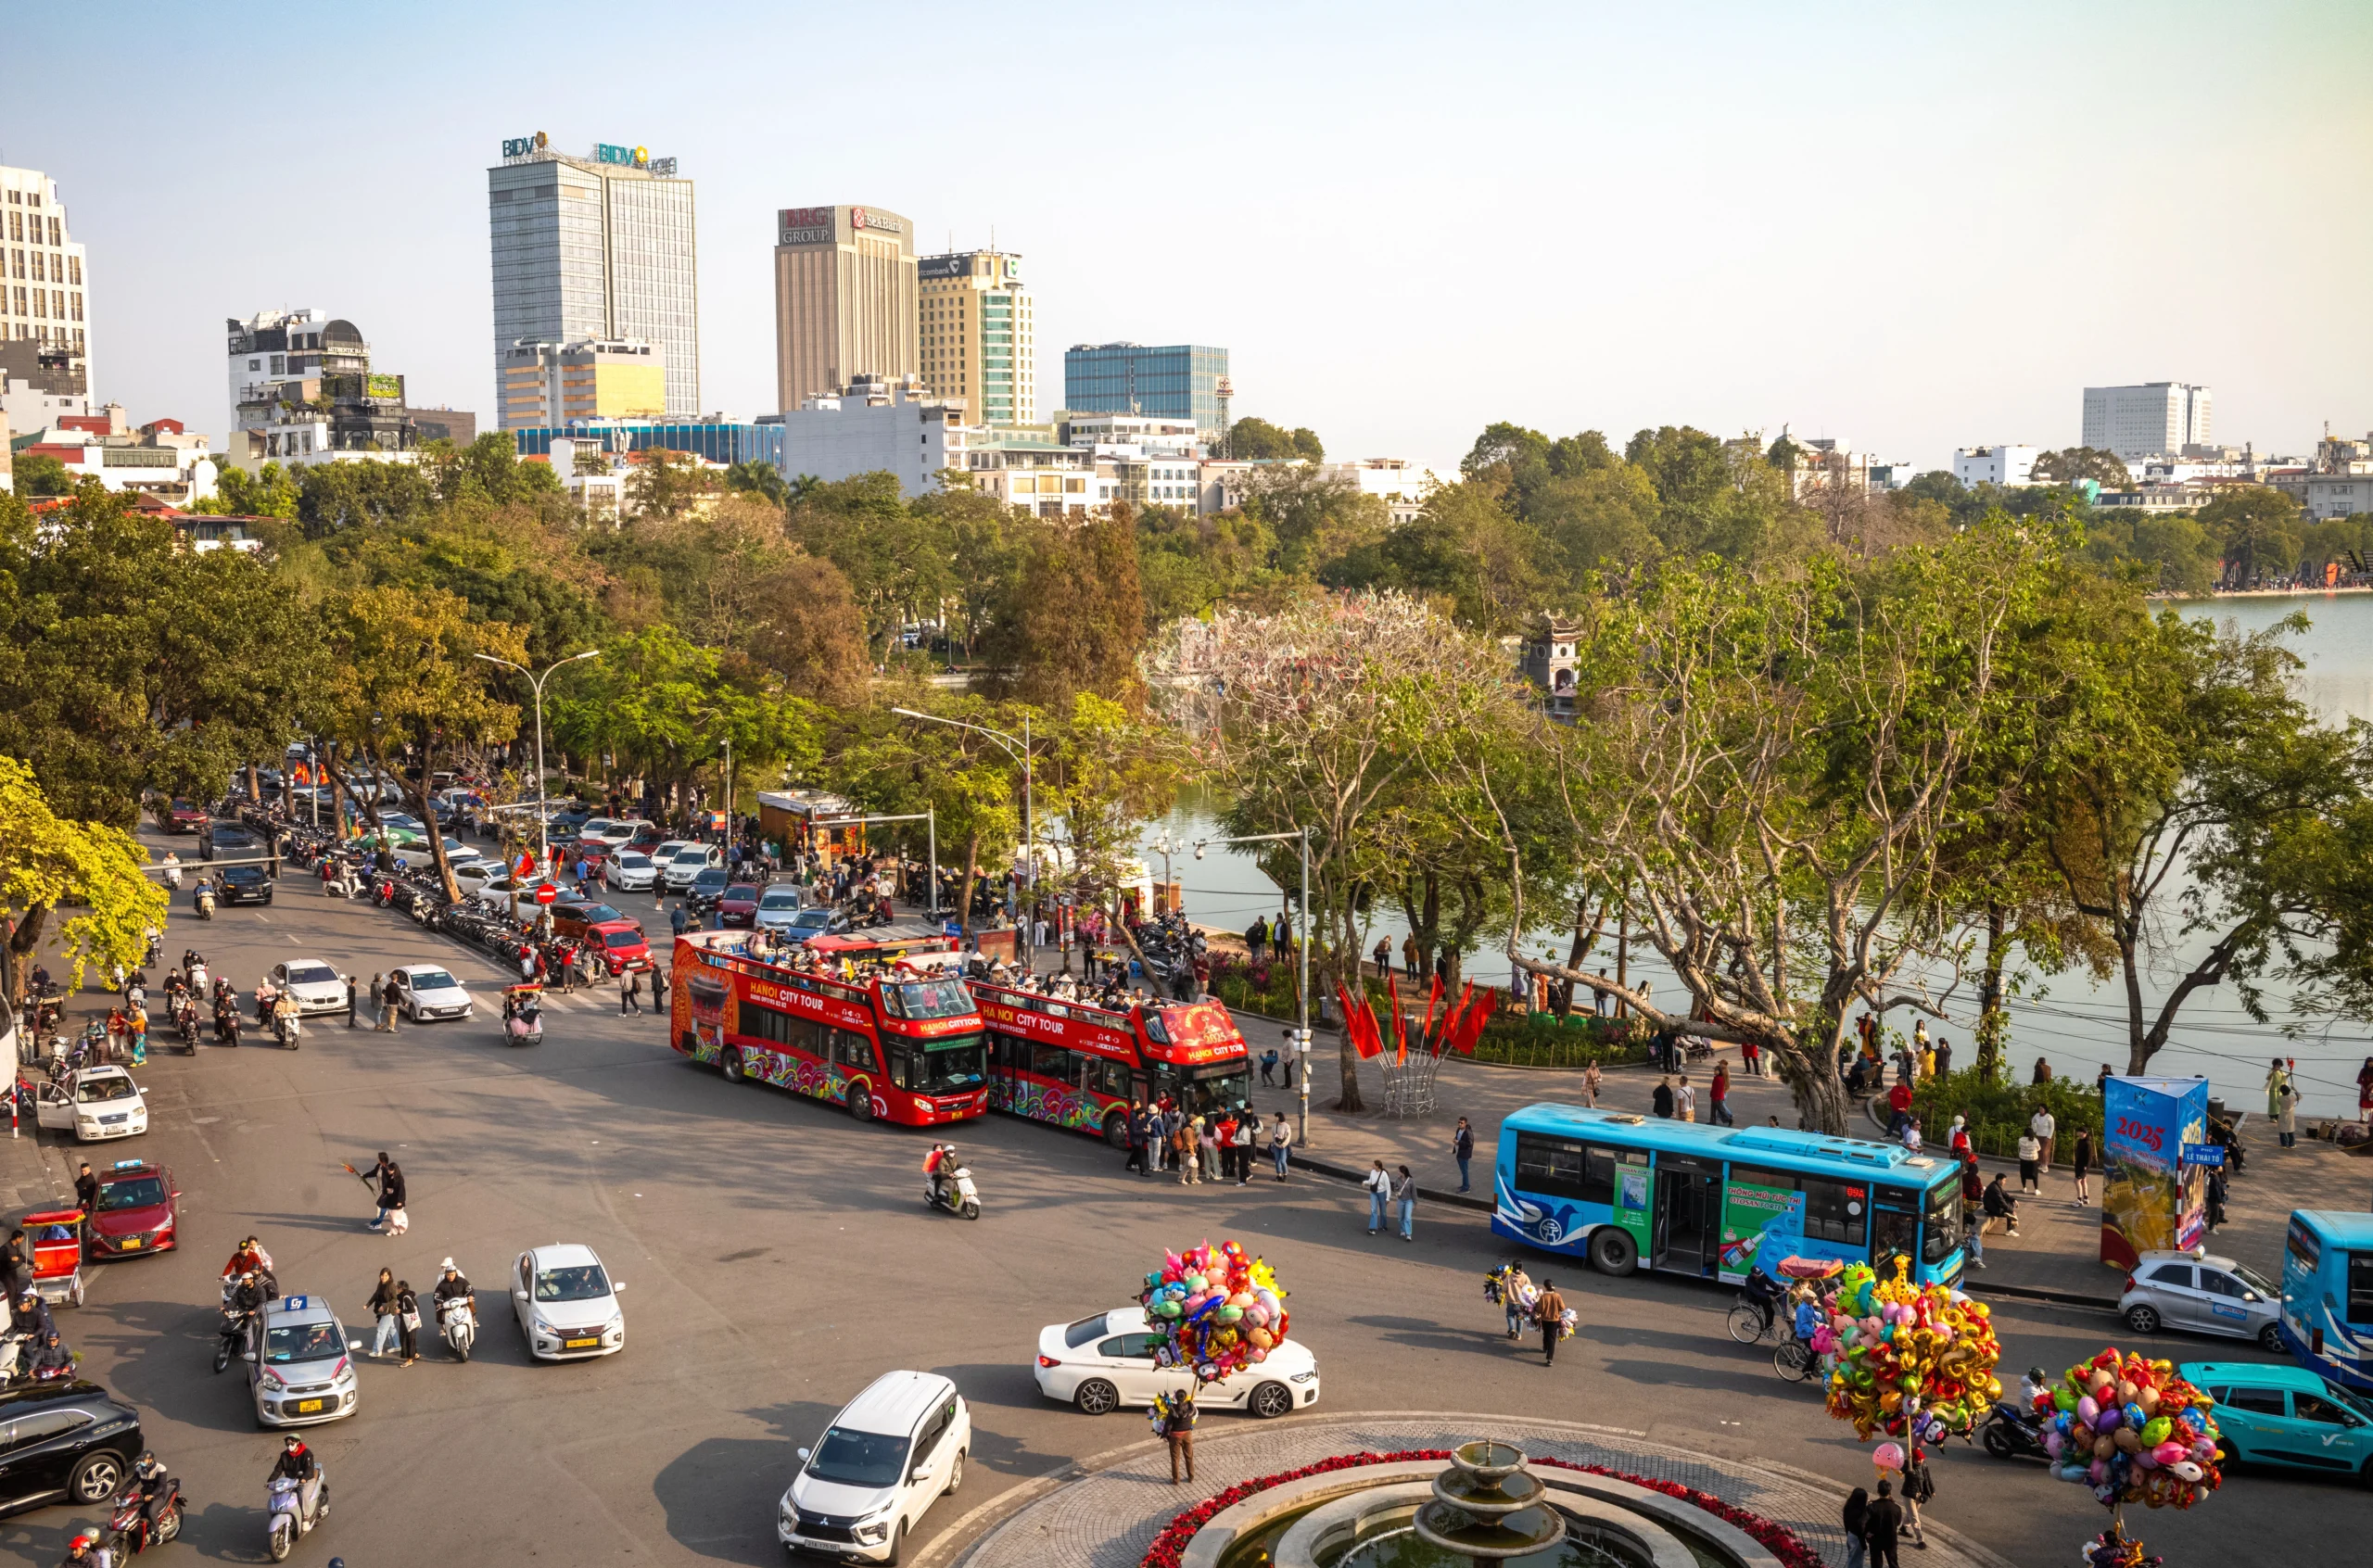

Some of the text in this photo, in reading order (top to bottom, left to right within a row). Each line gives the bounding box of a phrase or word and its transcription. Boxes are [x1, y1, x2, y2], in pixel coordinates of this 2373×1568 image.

[502, 136, 535, 158] BIDV
[599, 144, 636, 165] BIDV
[786, 207, 826, 228] BRG
[783, 230, 829, 244] GROUP
[750, 981, 823, 1011] HANOI CITY TOUR
[920, 1021, 947, 1032] HANOI
[983, 1005, 1064, 1034] HA NOI CITY TOUR
[1203, 1031, 1227, 1044] 2025
[1188, 1049, 1212, 1059] HANOI
[1229, 1043, 1244, 1053] TOUR
[2115, 1117, 2165, 1152] 2025
[2187, 1152, 2195, 1160] LÊ
[1727, 1185, 1802, 1205] THÔNG MŨI TỨC THÌ
[1846, 1186, 1865, 1198] 09A
[1730, 1197, 1783, 1211] OTOSAN FORTE
[290, 1298, 302, 1309] G7
